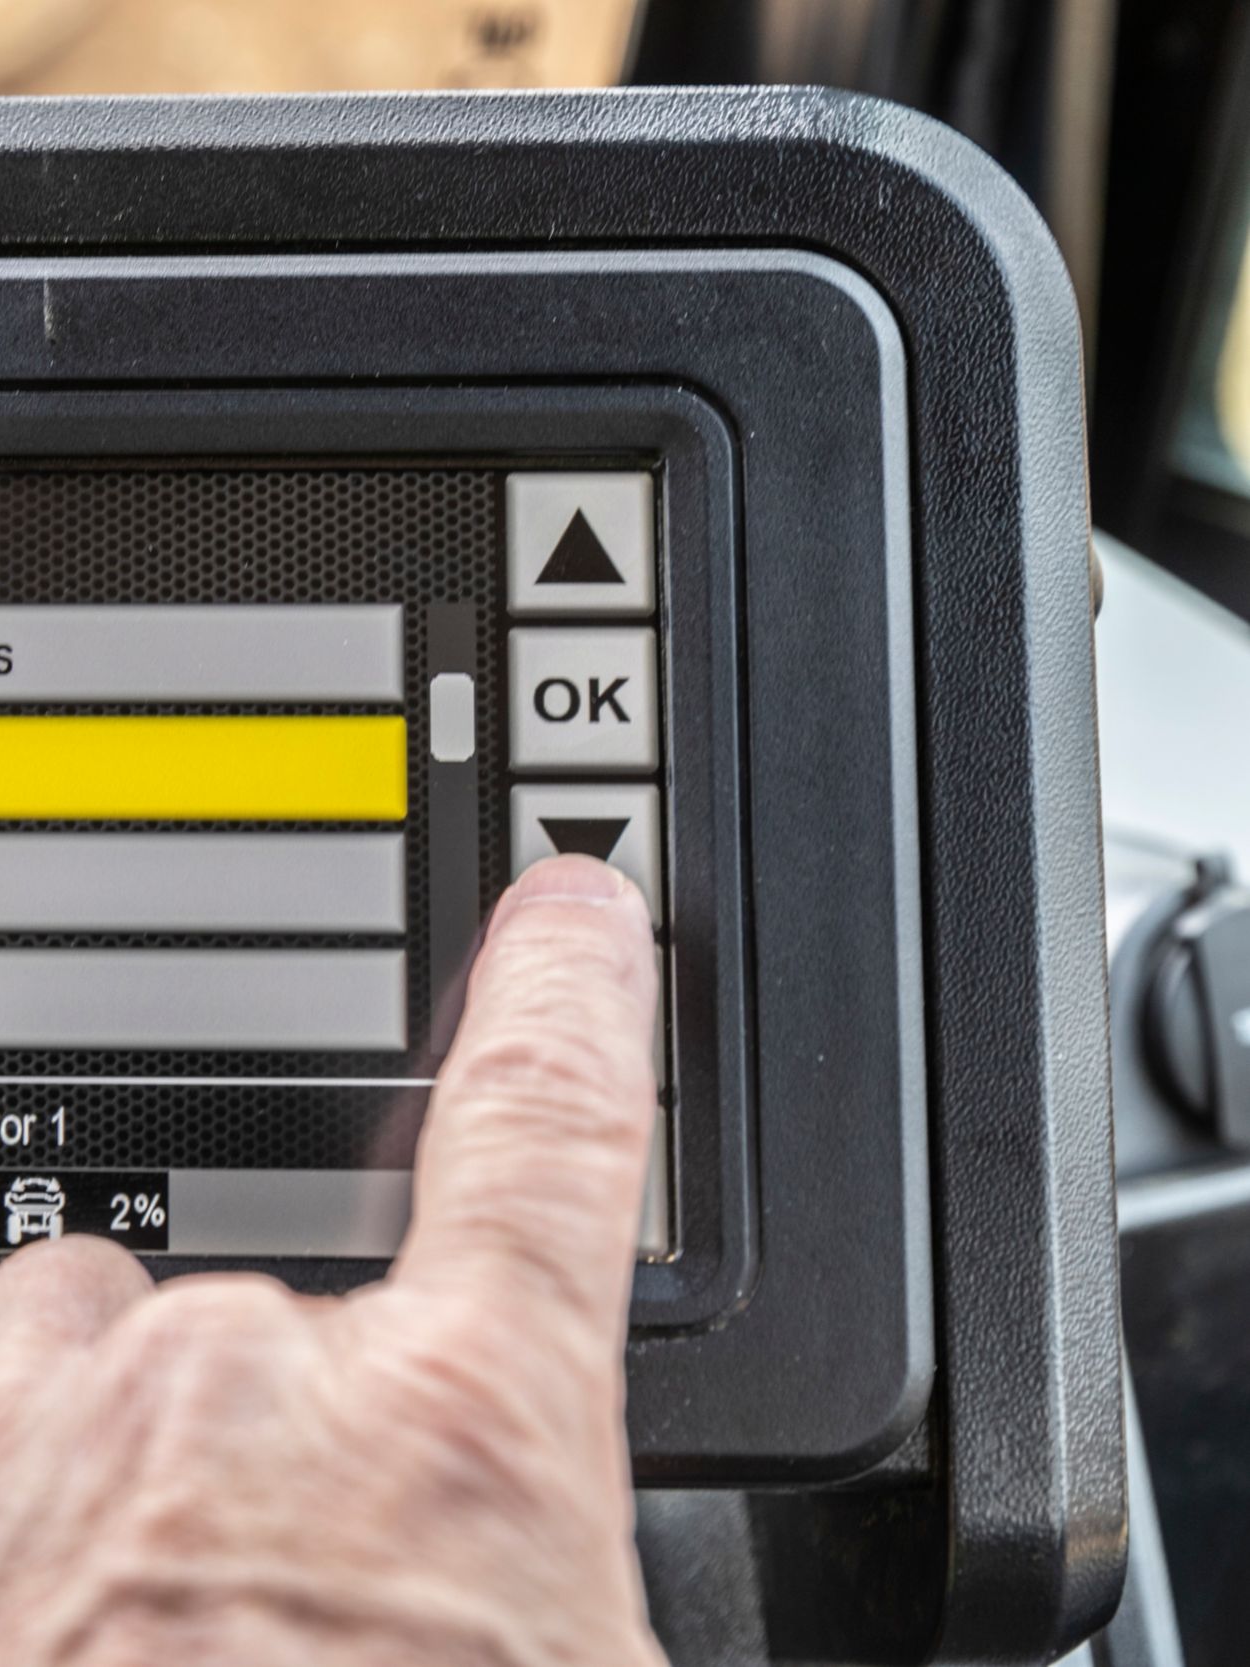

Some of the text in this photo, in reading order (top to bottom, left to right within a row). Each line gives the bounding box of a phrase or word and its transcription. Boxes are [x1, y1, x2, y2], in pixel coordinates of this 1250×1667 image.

[533, 677, 631, 723] OK
[51, 1106, 65, 1146] 1
[110, 1193, 166, 1230] 2%
